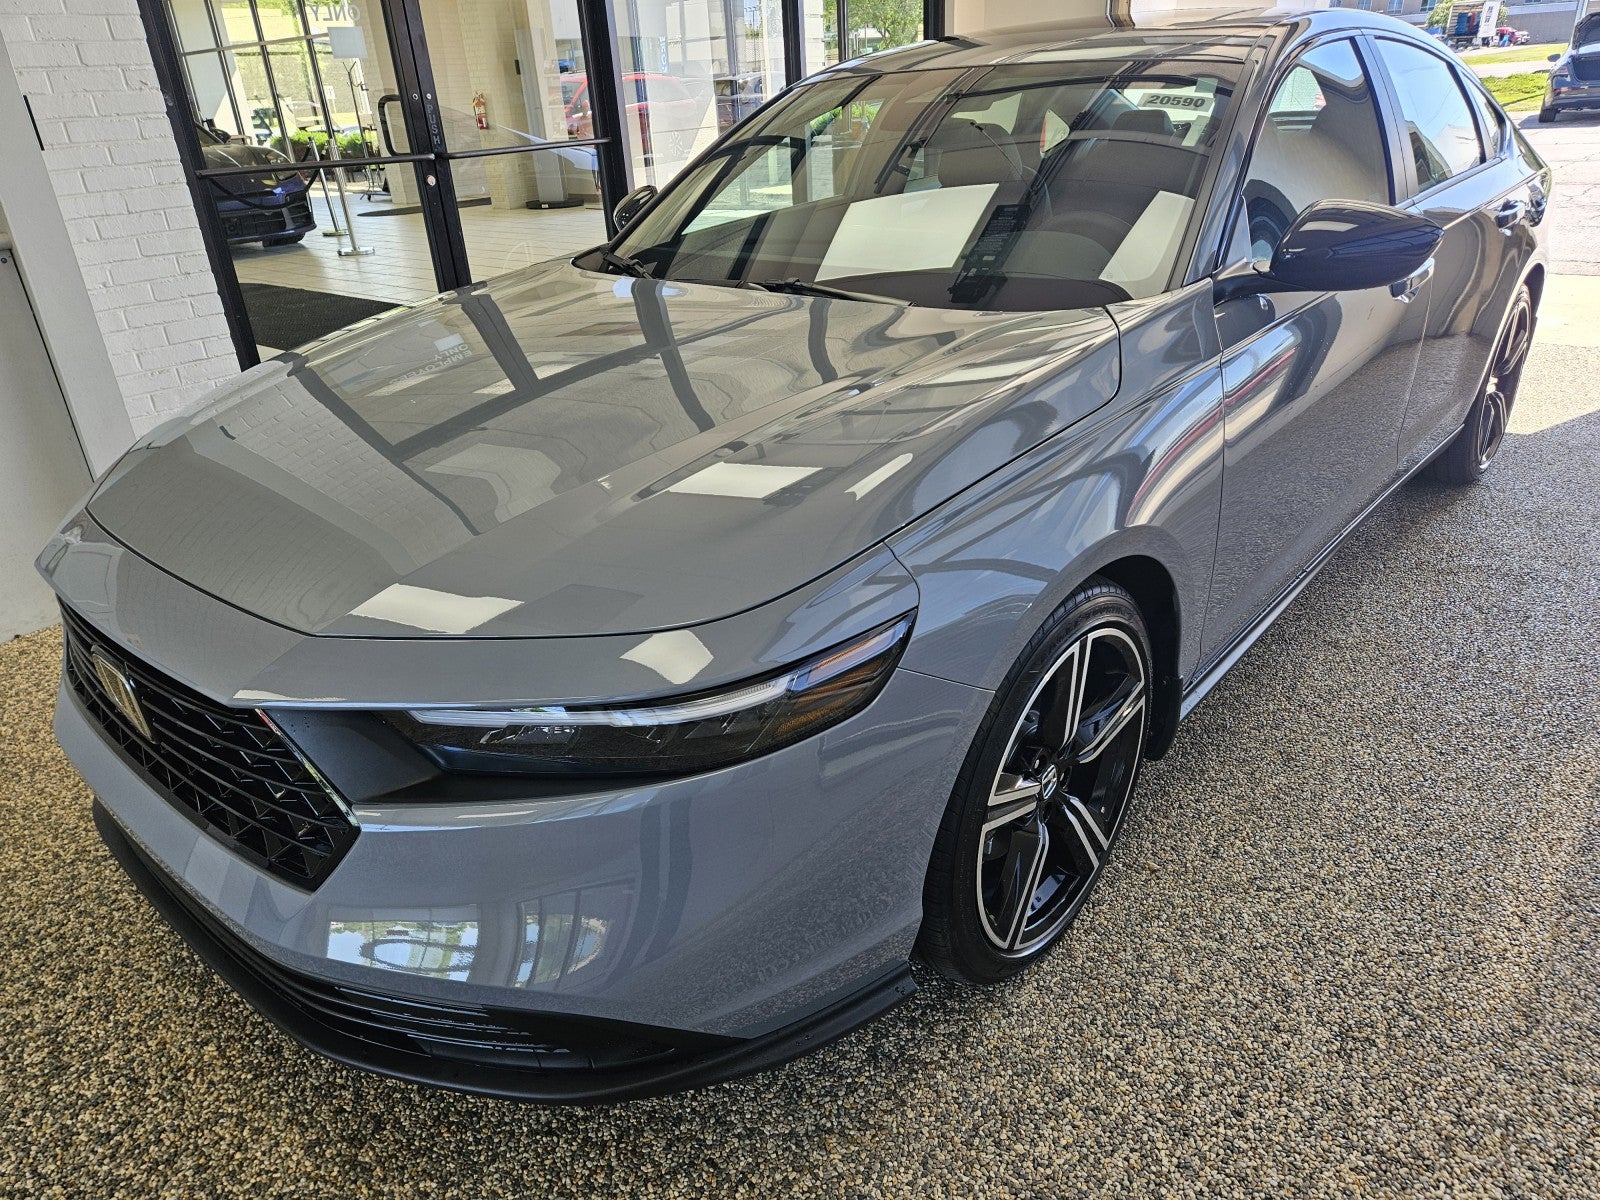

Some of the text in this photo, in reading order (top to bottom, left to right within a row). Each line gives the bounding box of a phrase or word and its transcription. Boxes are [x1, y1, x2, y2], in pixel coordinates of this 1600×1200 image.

[1147, 95, 1206, 108] 20590
[427, 104, 440, 144] PUSH
[433, 343, 469, 361] ONLY
